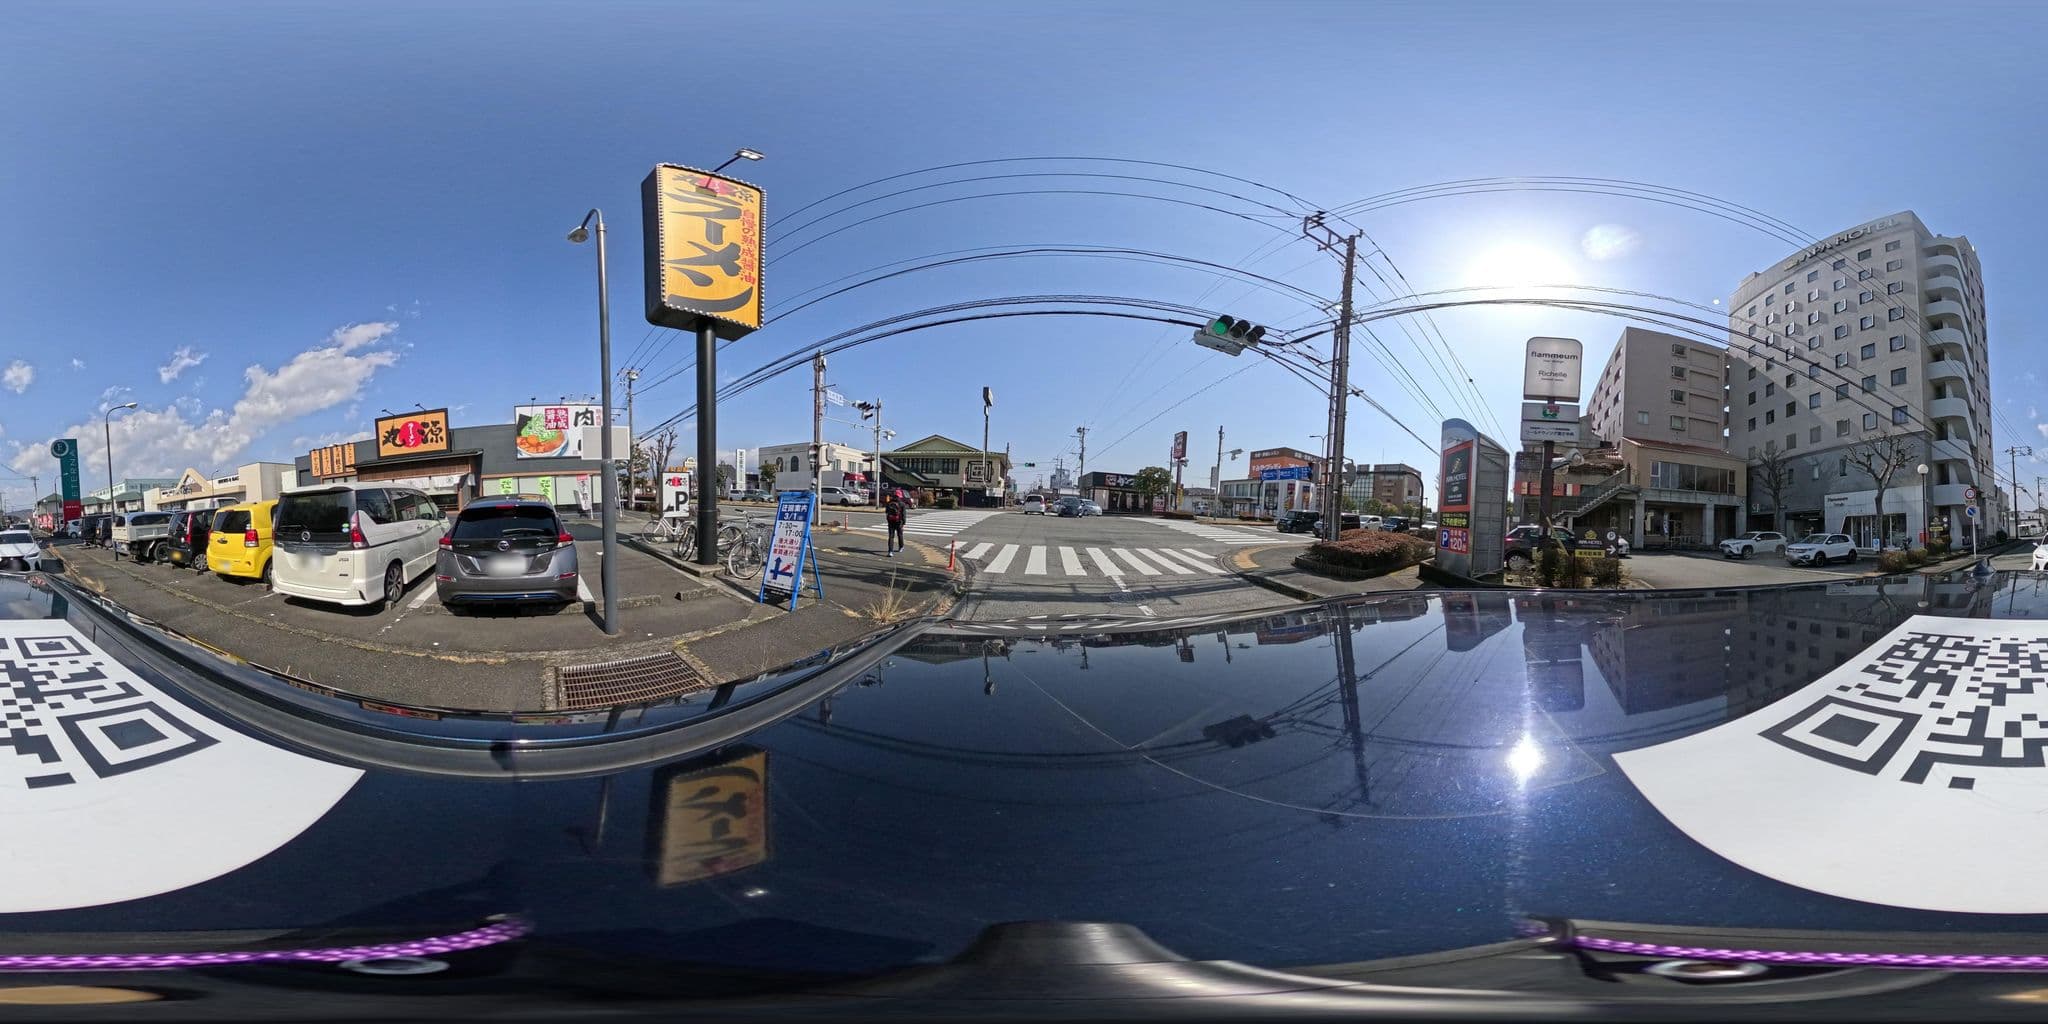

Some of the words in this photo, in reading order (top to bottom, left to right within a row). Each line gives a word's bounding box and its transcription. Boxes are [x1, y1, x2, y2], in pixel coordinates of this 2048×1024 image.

[1835, 219, 1899, 246] HOTEL
[663, 188, 754, 313] ラーメン
[69, 448, 79, 497] ETERNA
[675, 491, 688, 512] P
[785, 529, 803, 538] 17:00
[1442, 531, 1448, 545] P
